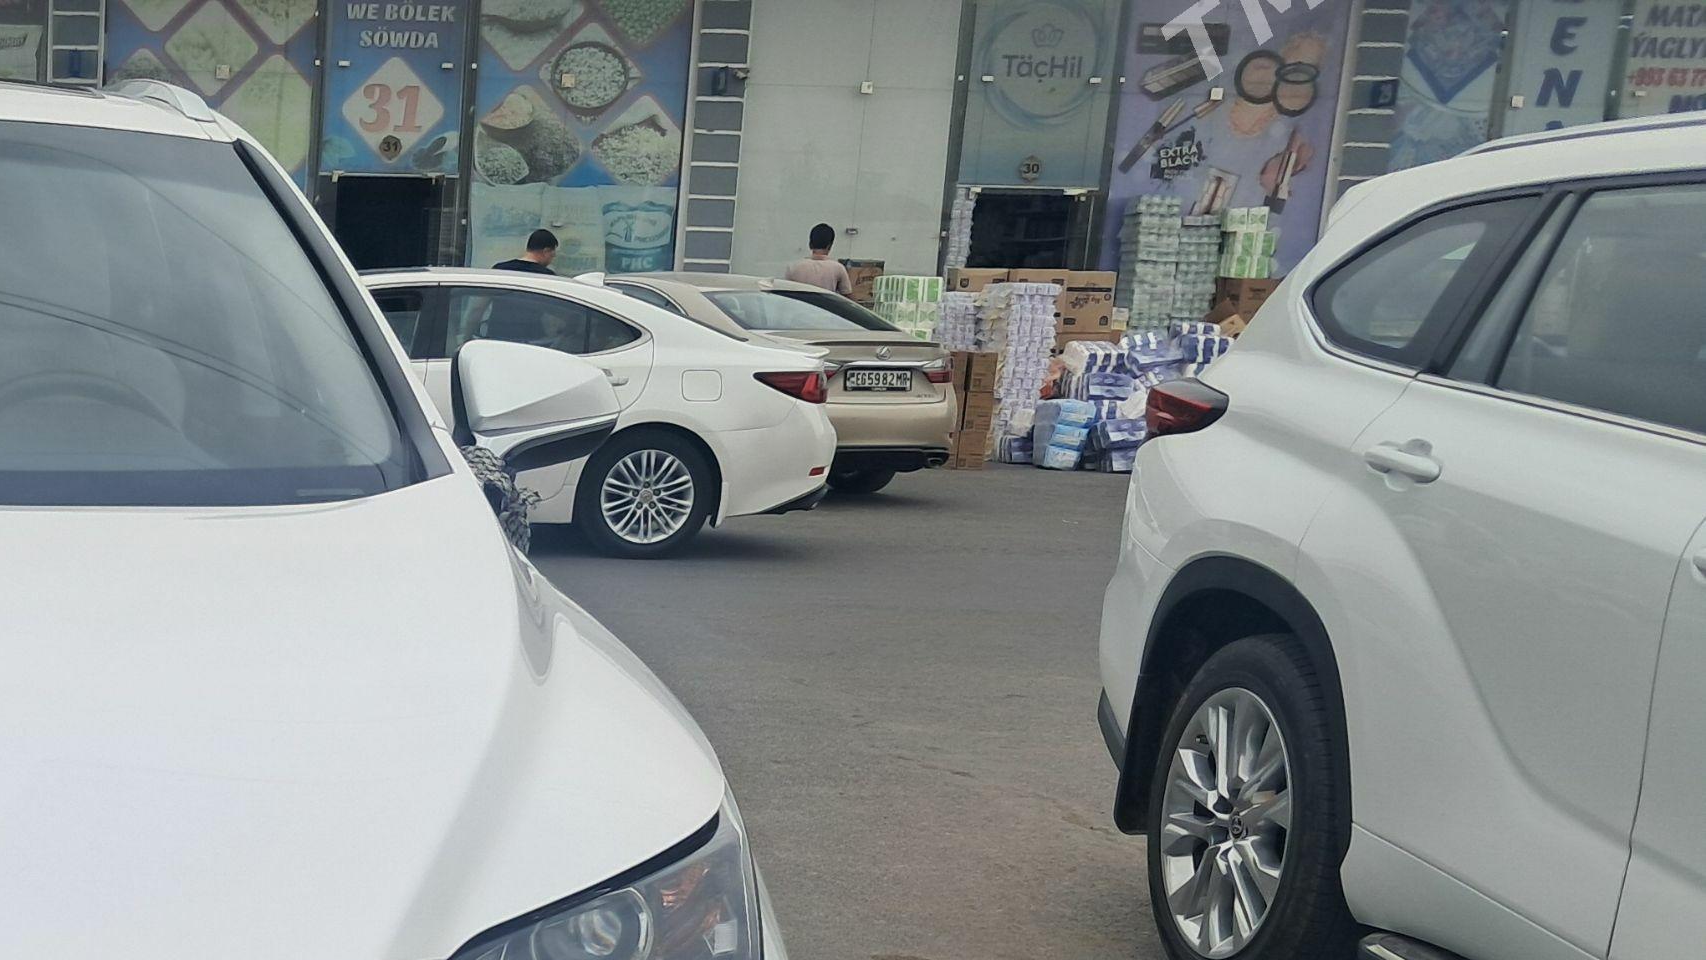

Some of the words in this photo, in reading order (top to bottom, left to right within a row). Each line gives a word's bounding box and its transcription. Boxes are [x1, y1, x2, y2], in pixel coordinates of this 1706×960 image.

[346, 2, 380, 20] WE
[358, 25, 440, 49] SÖWDA
[1001, 53, 1084, 83] TäçHil
[358, 83, 423, 133] 31
[1159, 144, 1199, 158] EXTRA
[1022, 163, 1040, 174] 30
[1160, 154, 1200, 169] BLACK
